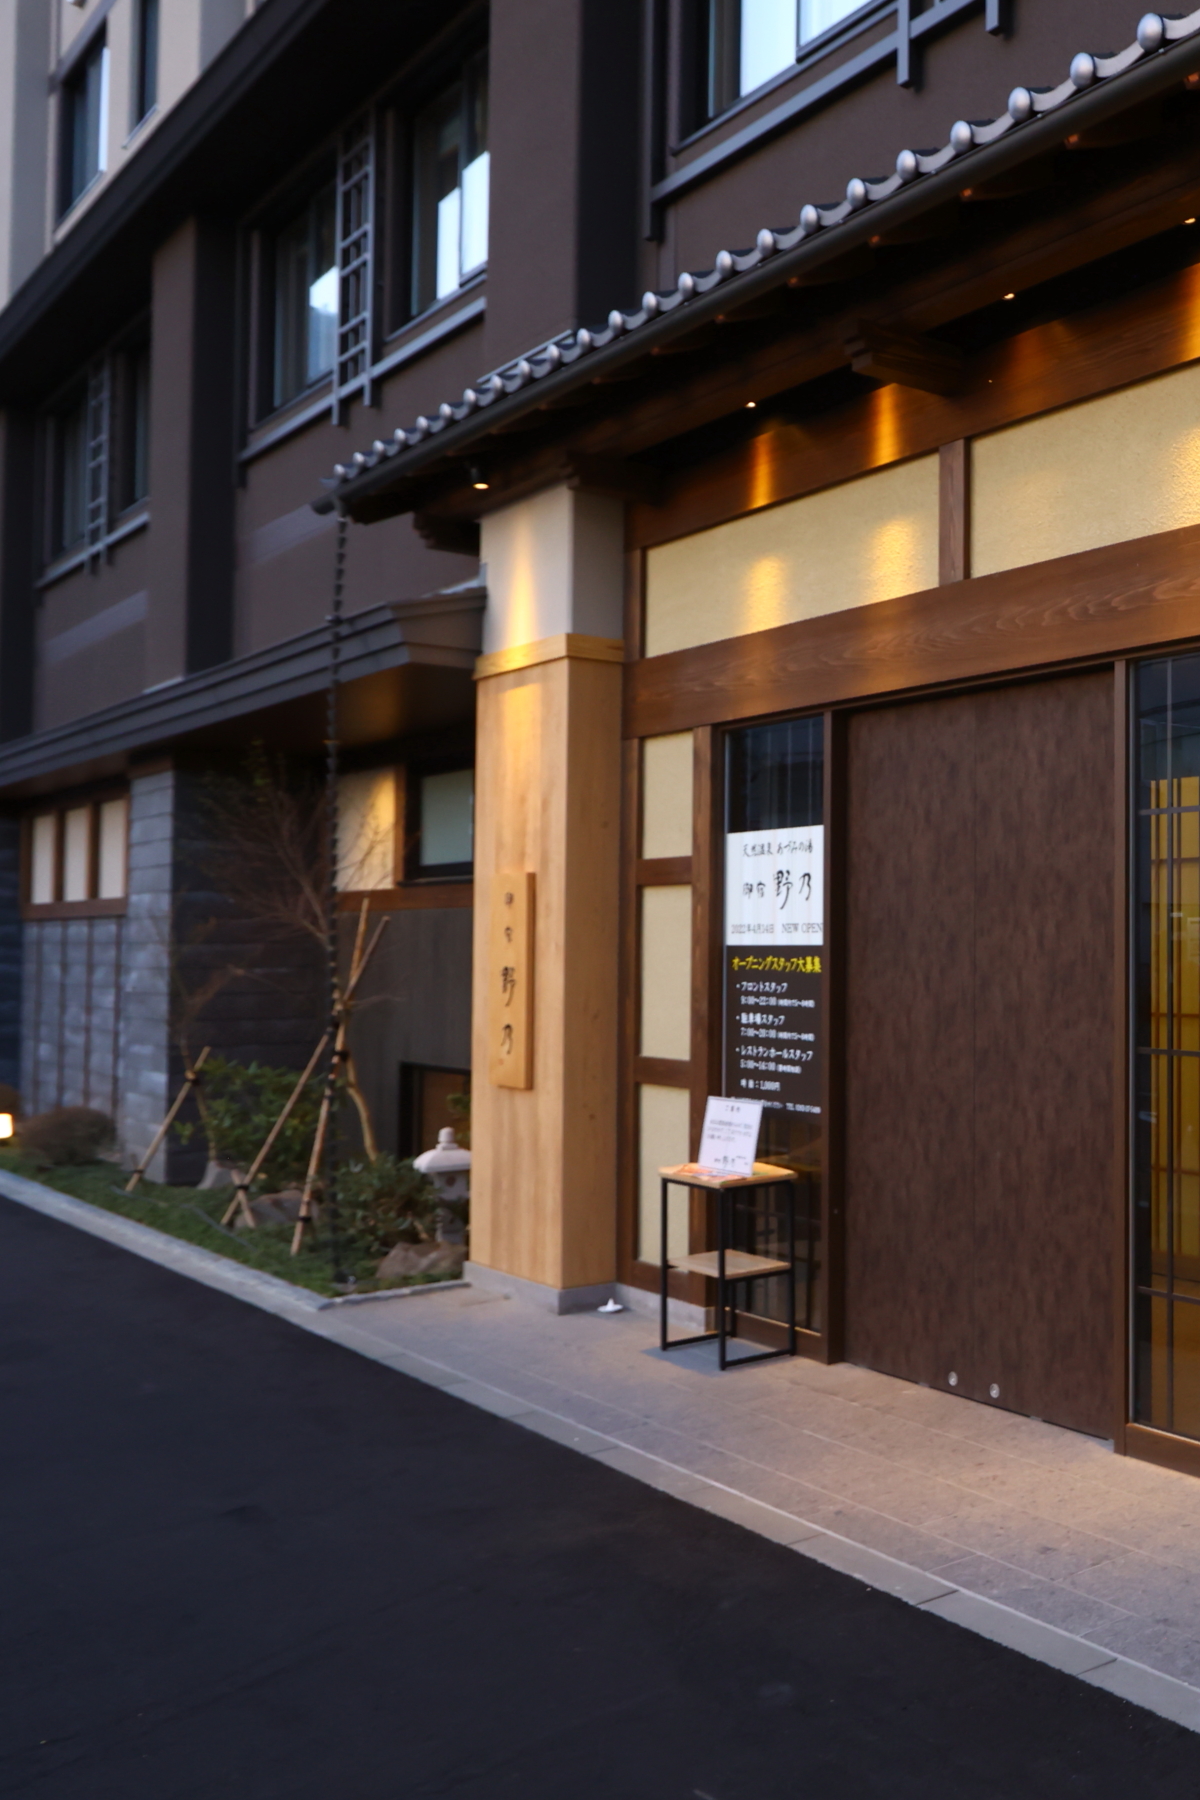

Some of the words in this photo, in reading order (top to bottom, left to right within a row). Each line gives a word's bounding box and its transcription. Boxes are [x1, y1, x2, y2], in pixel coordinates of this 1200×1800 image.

[773, 869, 813, 910] 野乃
[781, 922, 799, 934] NEW
[801, 922, 823, 934] OPEN
[731, 955, 822, 974] オープニングスタッフ大募集
[501, 965, 517, 1056] 野乃
